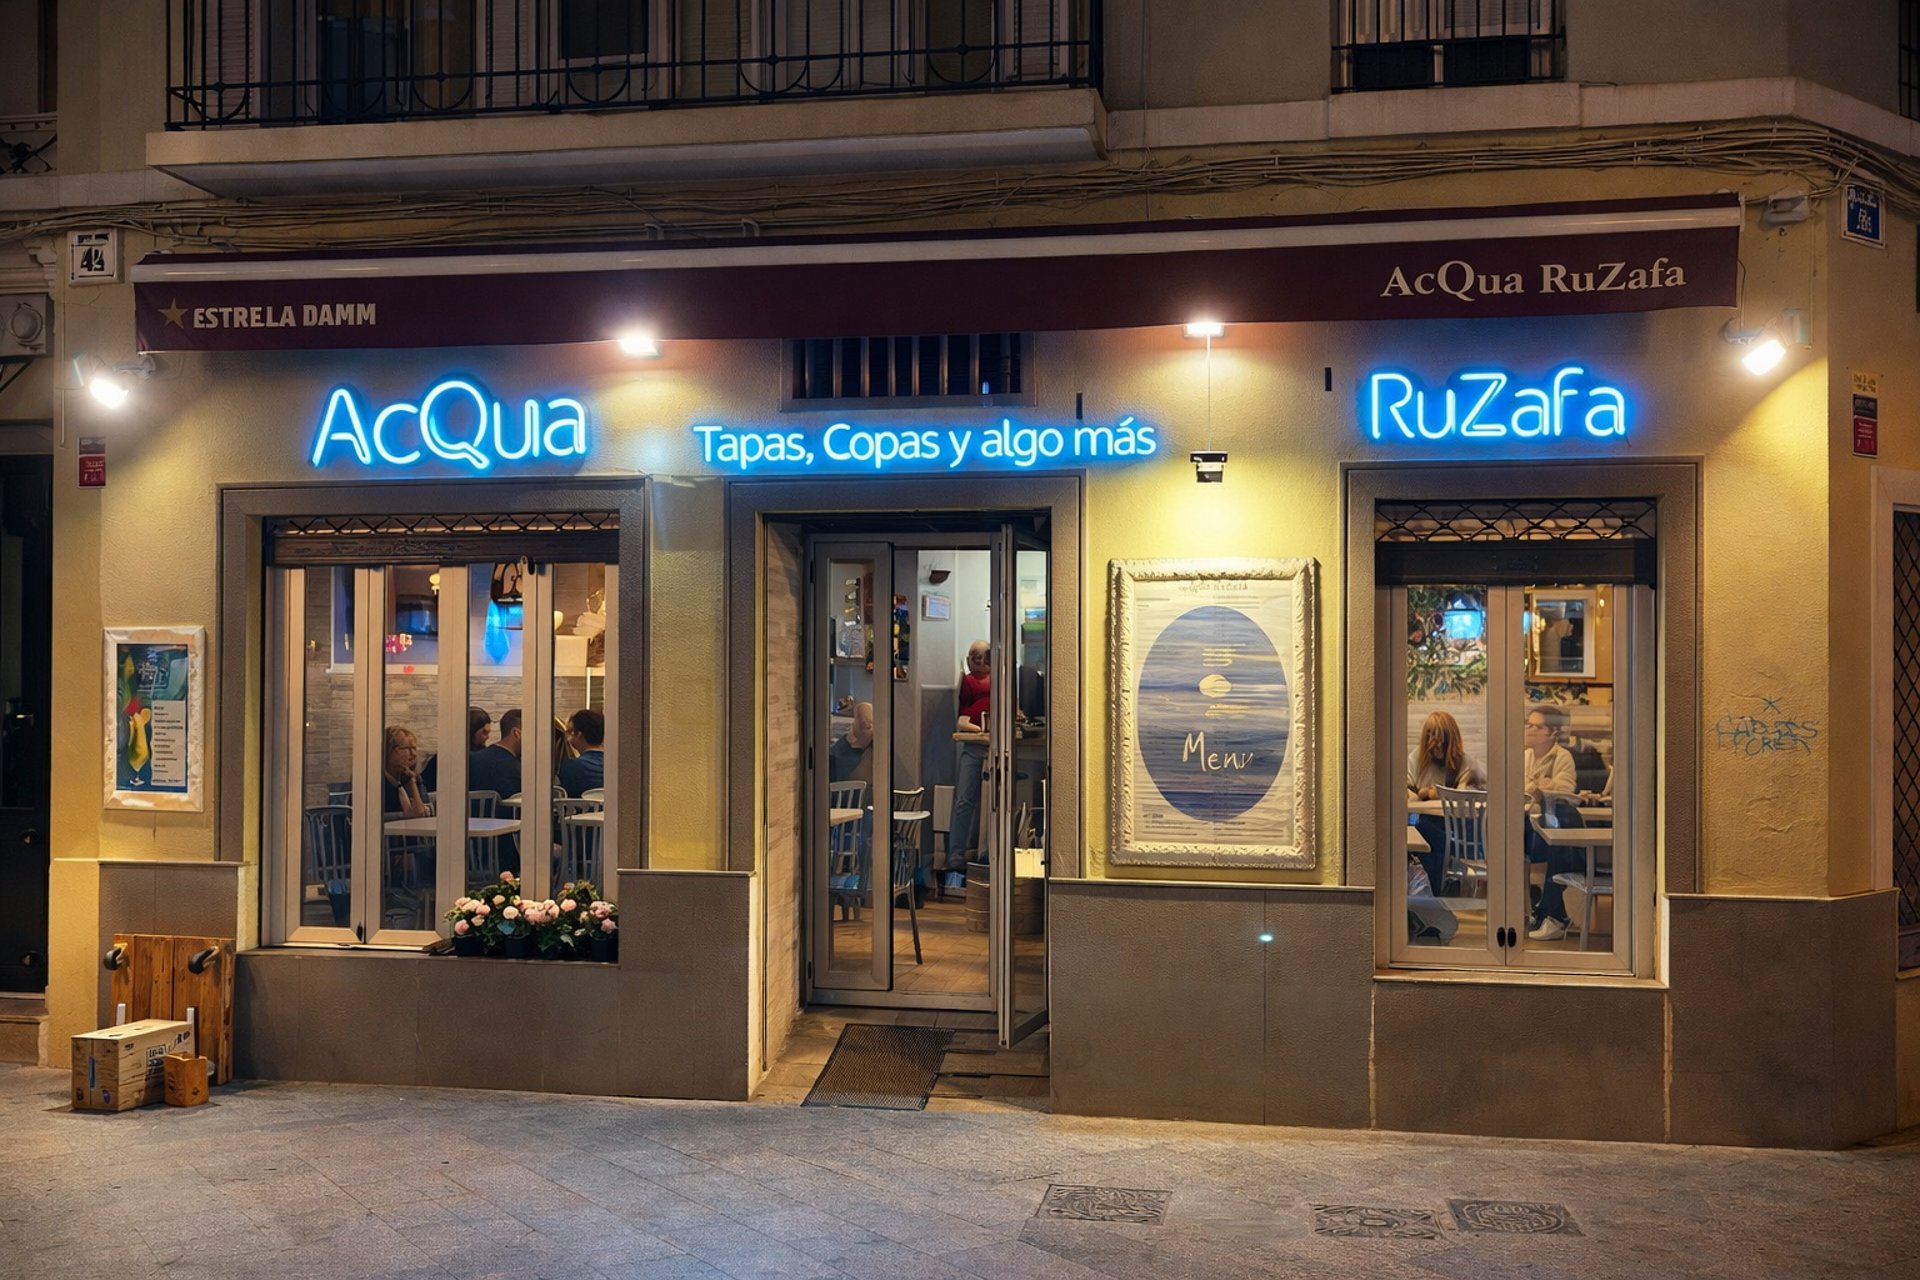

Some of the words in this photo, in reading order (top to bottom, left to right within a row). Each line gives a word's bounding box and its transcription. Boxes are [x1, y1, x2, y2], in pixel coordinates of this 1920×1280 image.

[1381, 260, 1525, 301] AcQua
[1538, 257, 1688, 294] RuZafa
[193, 306, 296, 329] ESTRELA
[303, 302, 377, 326] DAMM
[311, 379, 590, 471] AcQua
[1371, 366, 1627, 440] RuZafa
[692, 424, 815, 469] Tapas,
[823, 423, 940, 468] Copas
[948, 430, 973, 468] y
[981, 419, 1064, 467] algo
[1074, 416, 1157, 457] más
